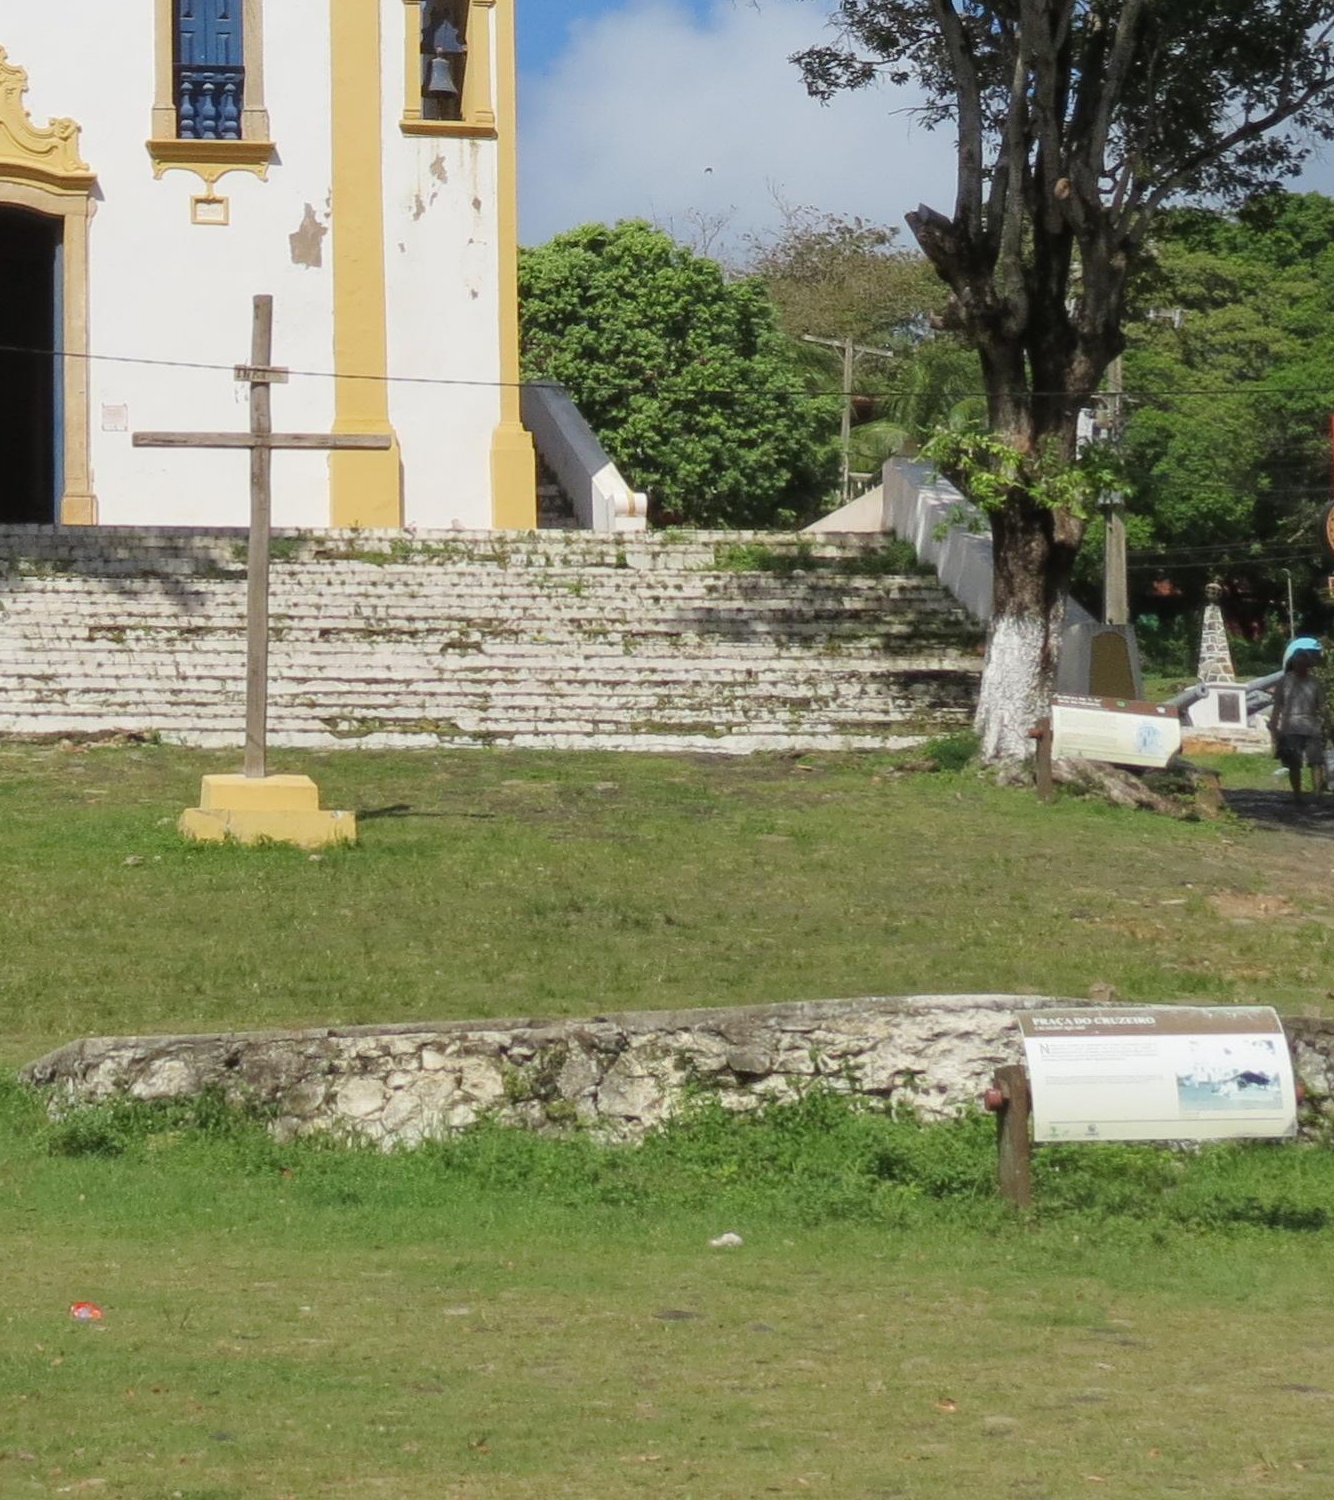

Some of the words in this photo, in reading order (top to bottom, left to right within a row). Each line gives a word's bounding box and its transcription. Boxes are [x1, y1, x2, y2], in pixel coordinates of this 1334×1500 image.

[1032, 1016, 1074, 1027] PRAÇA
[1074, 1017, 1092, 1026] DO
[1094, 1016, 1156, 1026] CRUZEIRO
